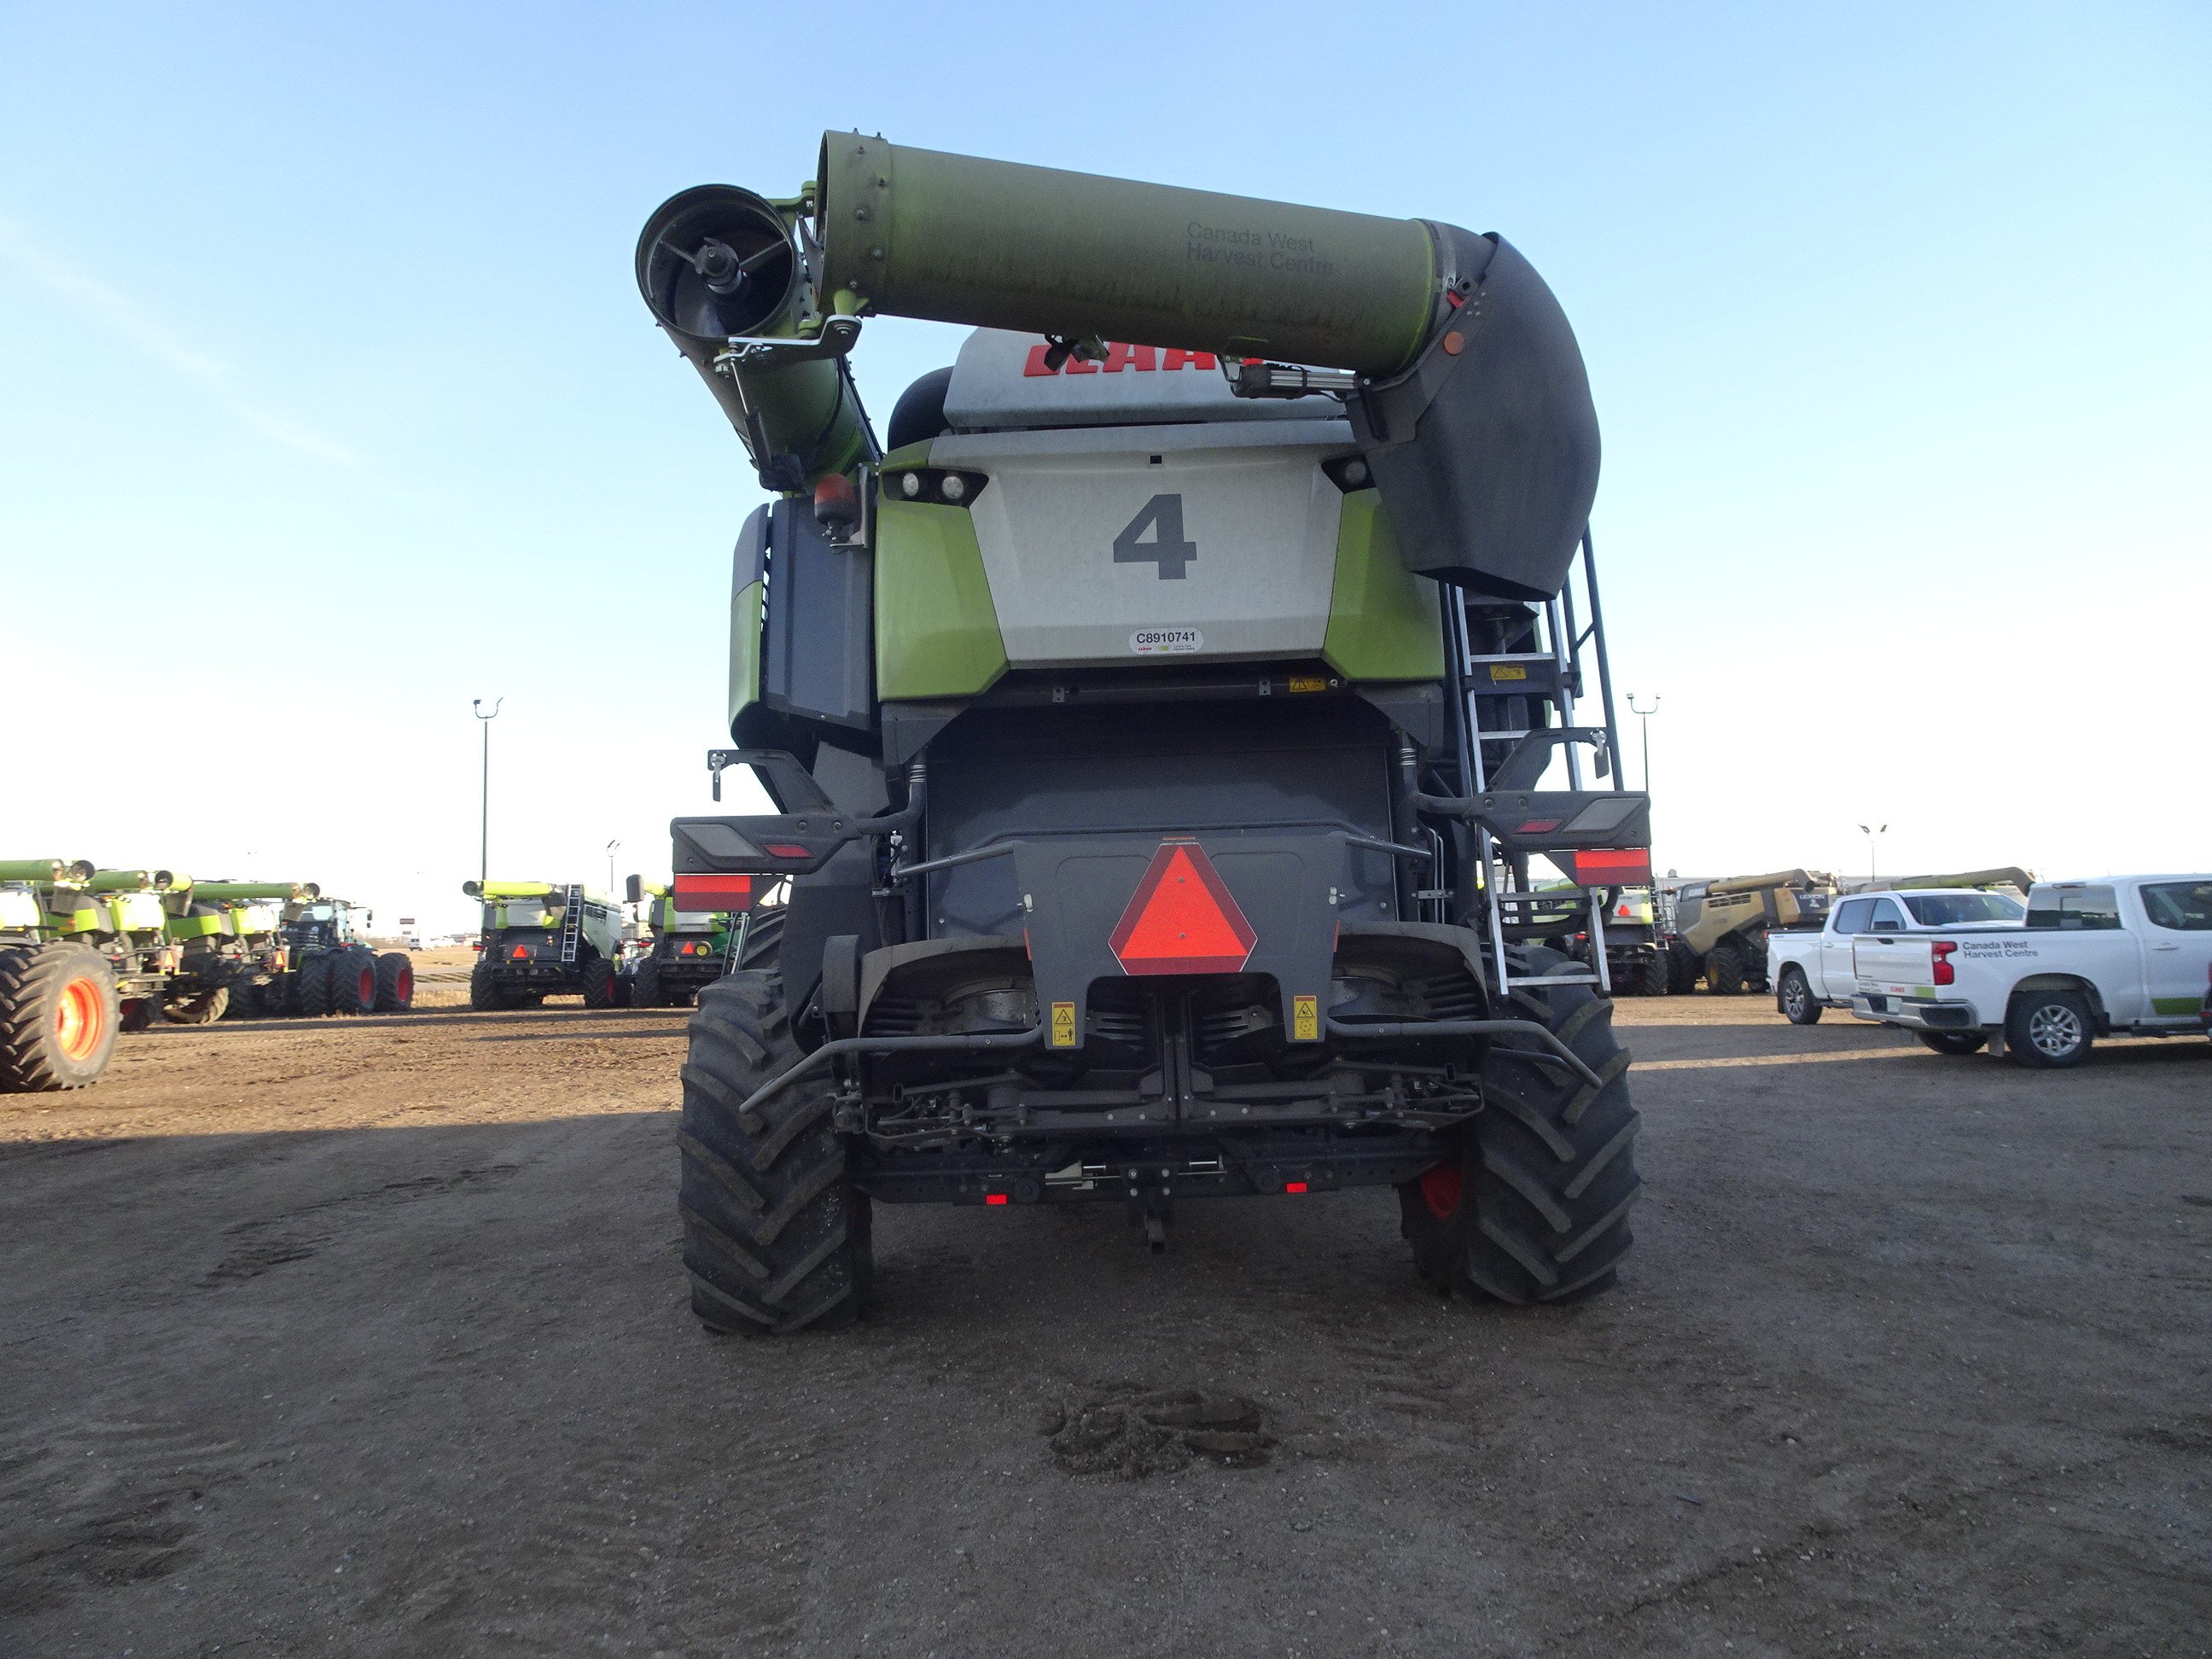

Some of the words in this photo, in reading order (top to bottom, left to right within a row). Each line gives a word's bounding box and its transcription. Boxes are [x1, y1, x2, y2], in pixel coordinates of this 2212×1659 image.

[1187, 222, 1261, 246] Canada
[1267, 231, 1316, 253] West
[1186, 241, 1265, 268] Harvest
[1270, 253, 1334, 274] Centre
[1112, 493, 1197, 579] 4
[1136, 632, 1195, 643] C8910741
[1963, 941, 2000, 950] Canada
[1965, 950, 2003, 958] Harvest
